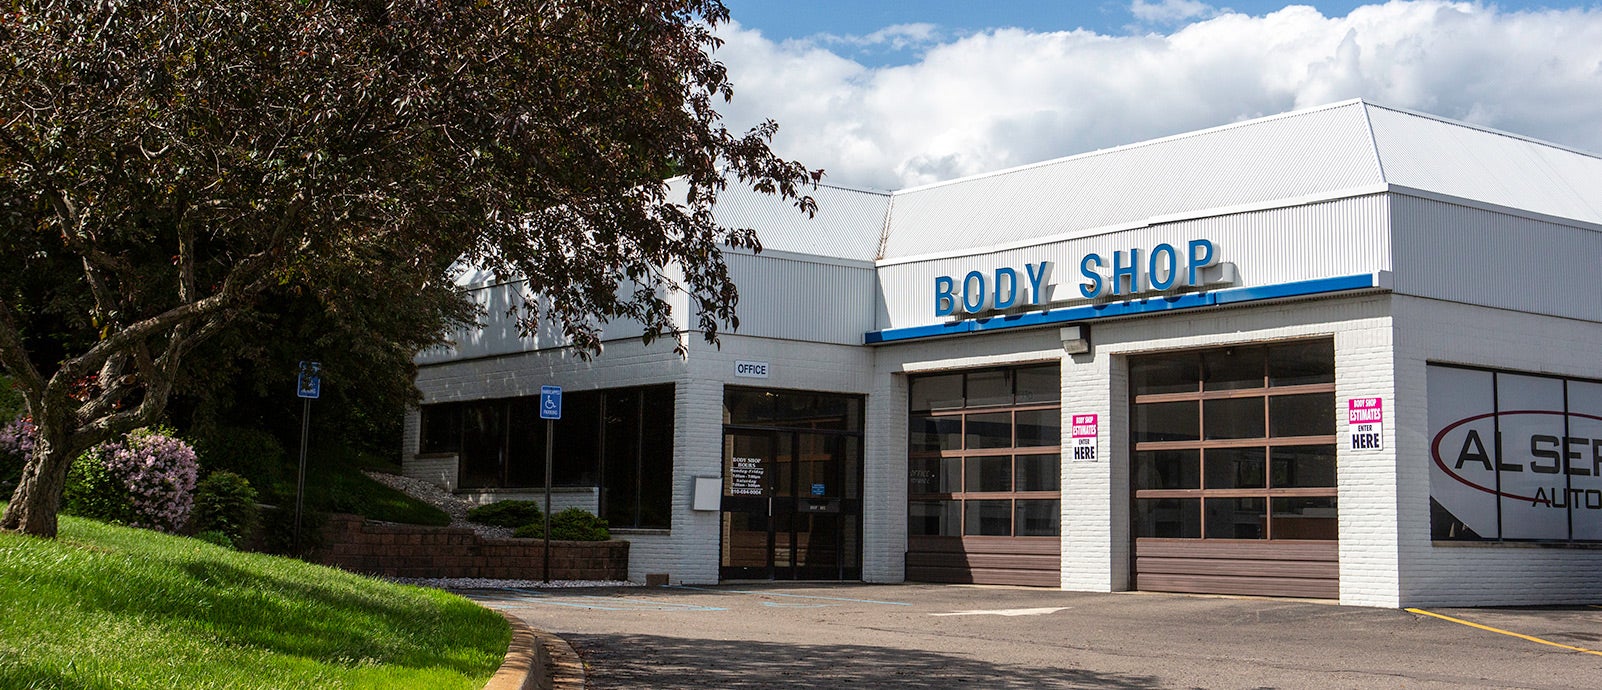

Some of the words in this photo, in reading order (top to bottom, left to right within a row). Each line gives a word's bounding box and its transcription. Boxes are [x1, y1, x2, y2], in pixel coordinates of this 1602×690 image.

[935, 261, 1050, 317] BODY
[1080, 238, 1216, 299] SHOP
[737, 363, 767, 375] OFFICE
[1353, 399, 1365, 408] BODY
[1365, 398, 1377, 407] SHOP
[1350, 408, 1381, 421] ESTIMATES
[1073, 425, 1096, 435] ESTIMATES
[1358, 424, 1373, 432] ENTER
[1352, 433, 1380, 449] HERE
[1074, 446, 1095, 460] HERE
[1455, 429, 1523, 472] AL
